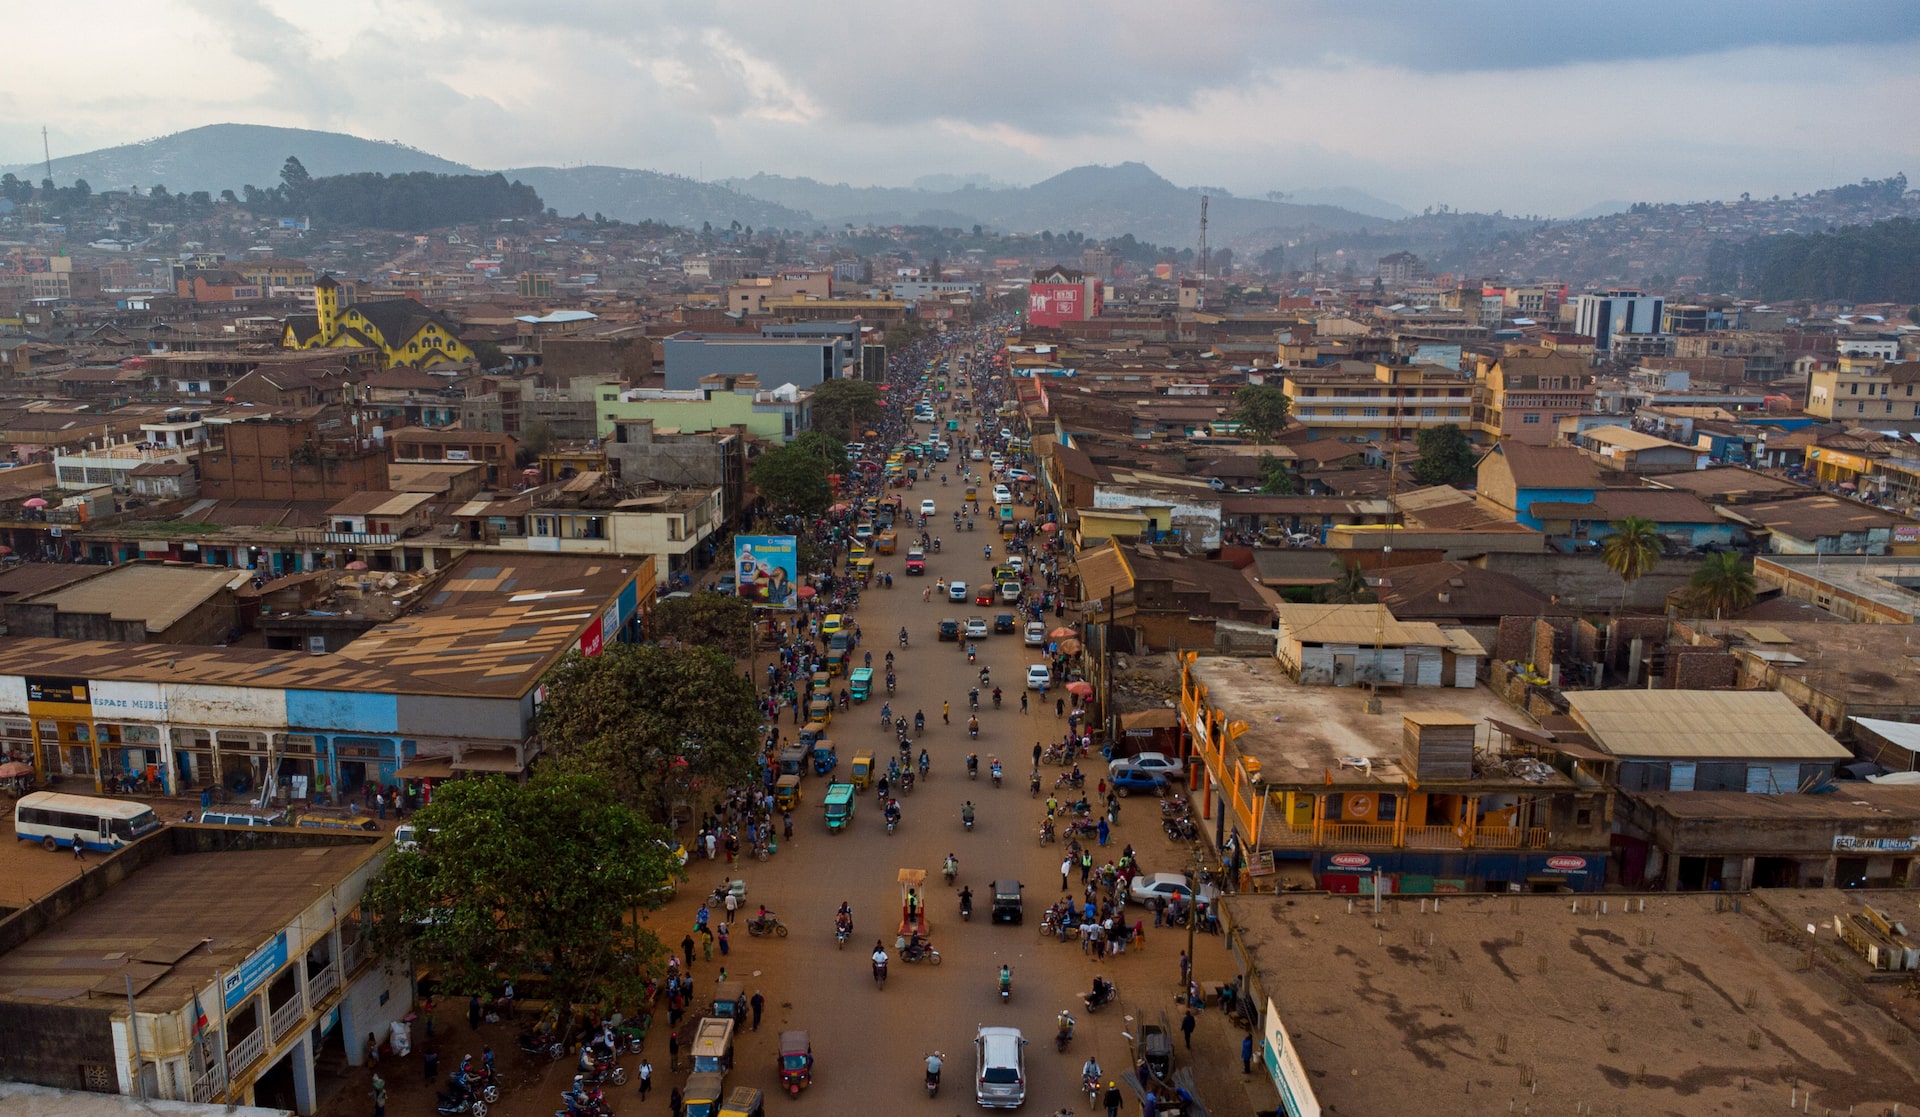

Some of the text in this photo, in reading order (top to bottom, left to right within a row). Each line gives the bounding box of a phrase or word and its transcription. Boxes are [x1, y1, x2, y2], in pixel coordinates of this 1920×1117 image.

[132, 700, 169, 710] MEUBLES
[1335, 856, 1366, 864] PLASCON
[1551, 859, 1582, 867] PLASCON
[226, 974, 240, 989] FPI
